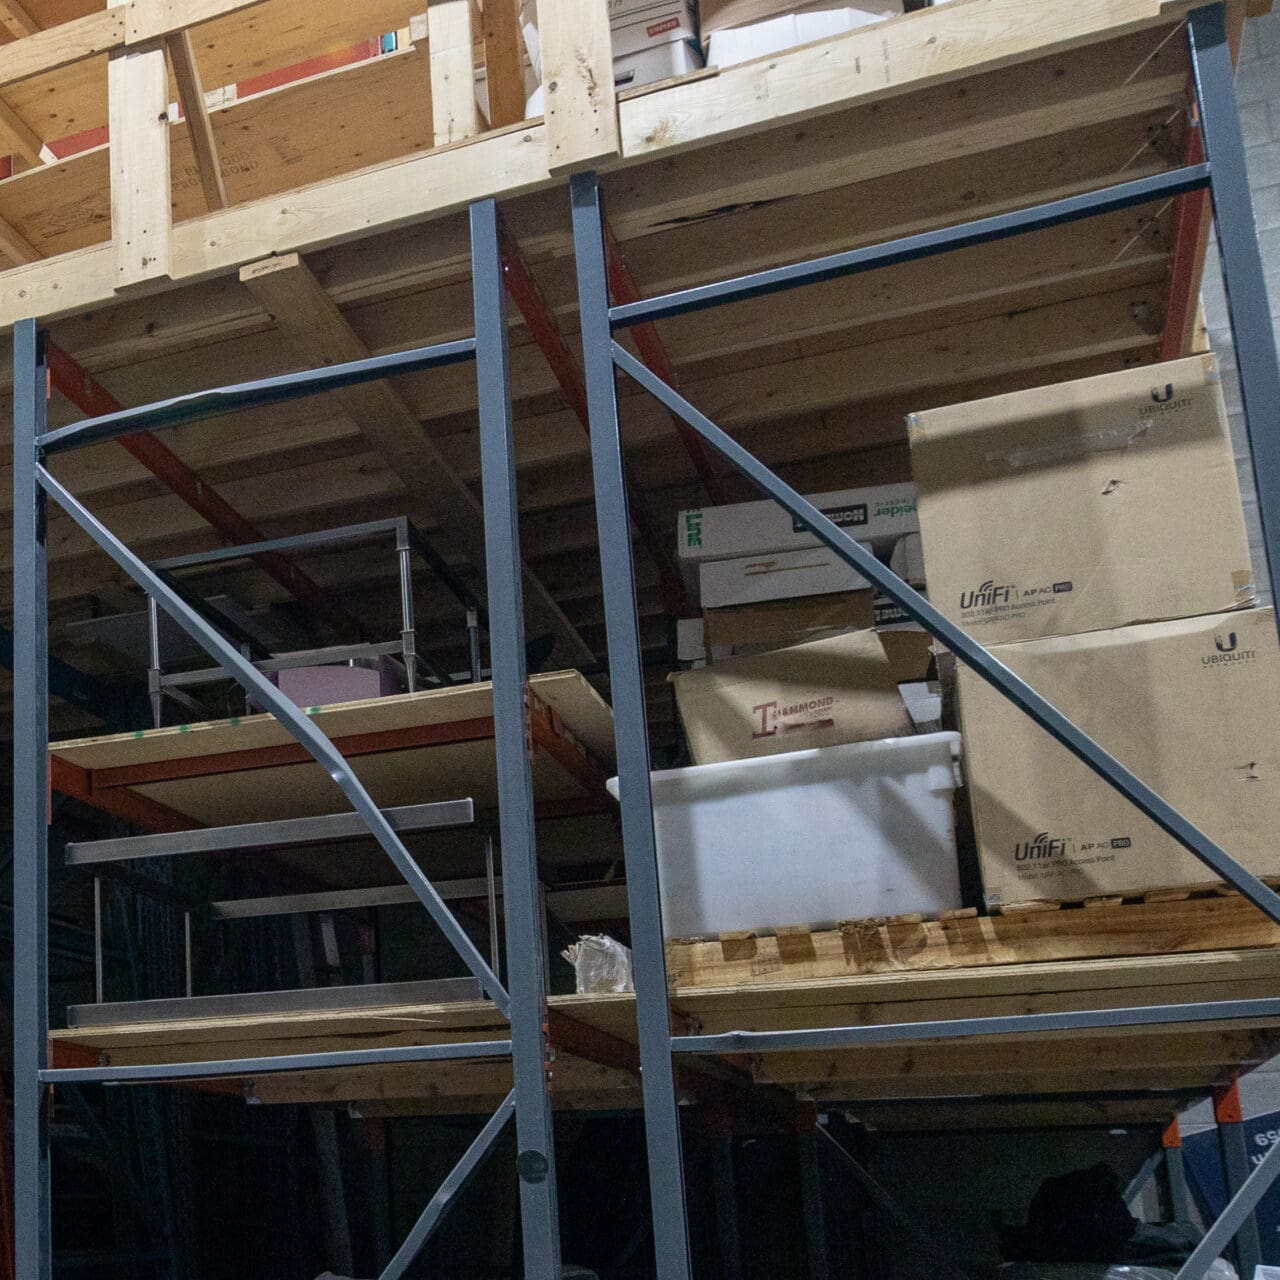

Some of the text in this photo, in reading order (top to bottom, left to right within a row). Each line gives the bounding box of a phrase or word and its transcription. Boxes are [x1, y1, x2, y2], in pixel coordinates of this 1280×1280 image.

[647, 18, 680, 36] STAPLES
[1139, 399, 1193, 415] UBIQUITI
[960, 584, 1010, 609] UniFi
[1023, 589, 1037, 597] AP
[1054, 583, 1072, 593] PRO
[1201, 650, 1256, 665] UBIQUITI
[1014, 837, 1067, 861] UniFi
[1080, 843, 1095, 851] AP
[1112, 839, 1130, 847] PRO
[1096, 854, 1116, 862] Point
